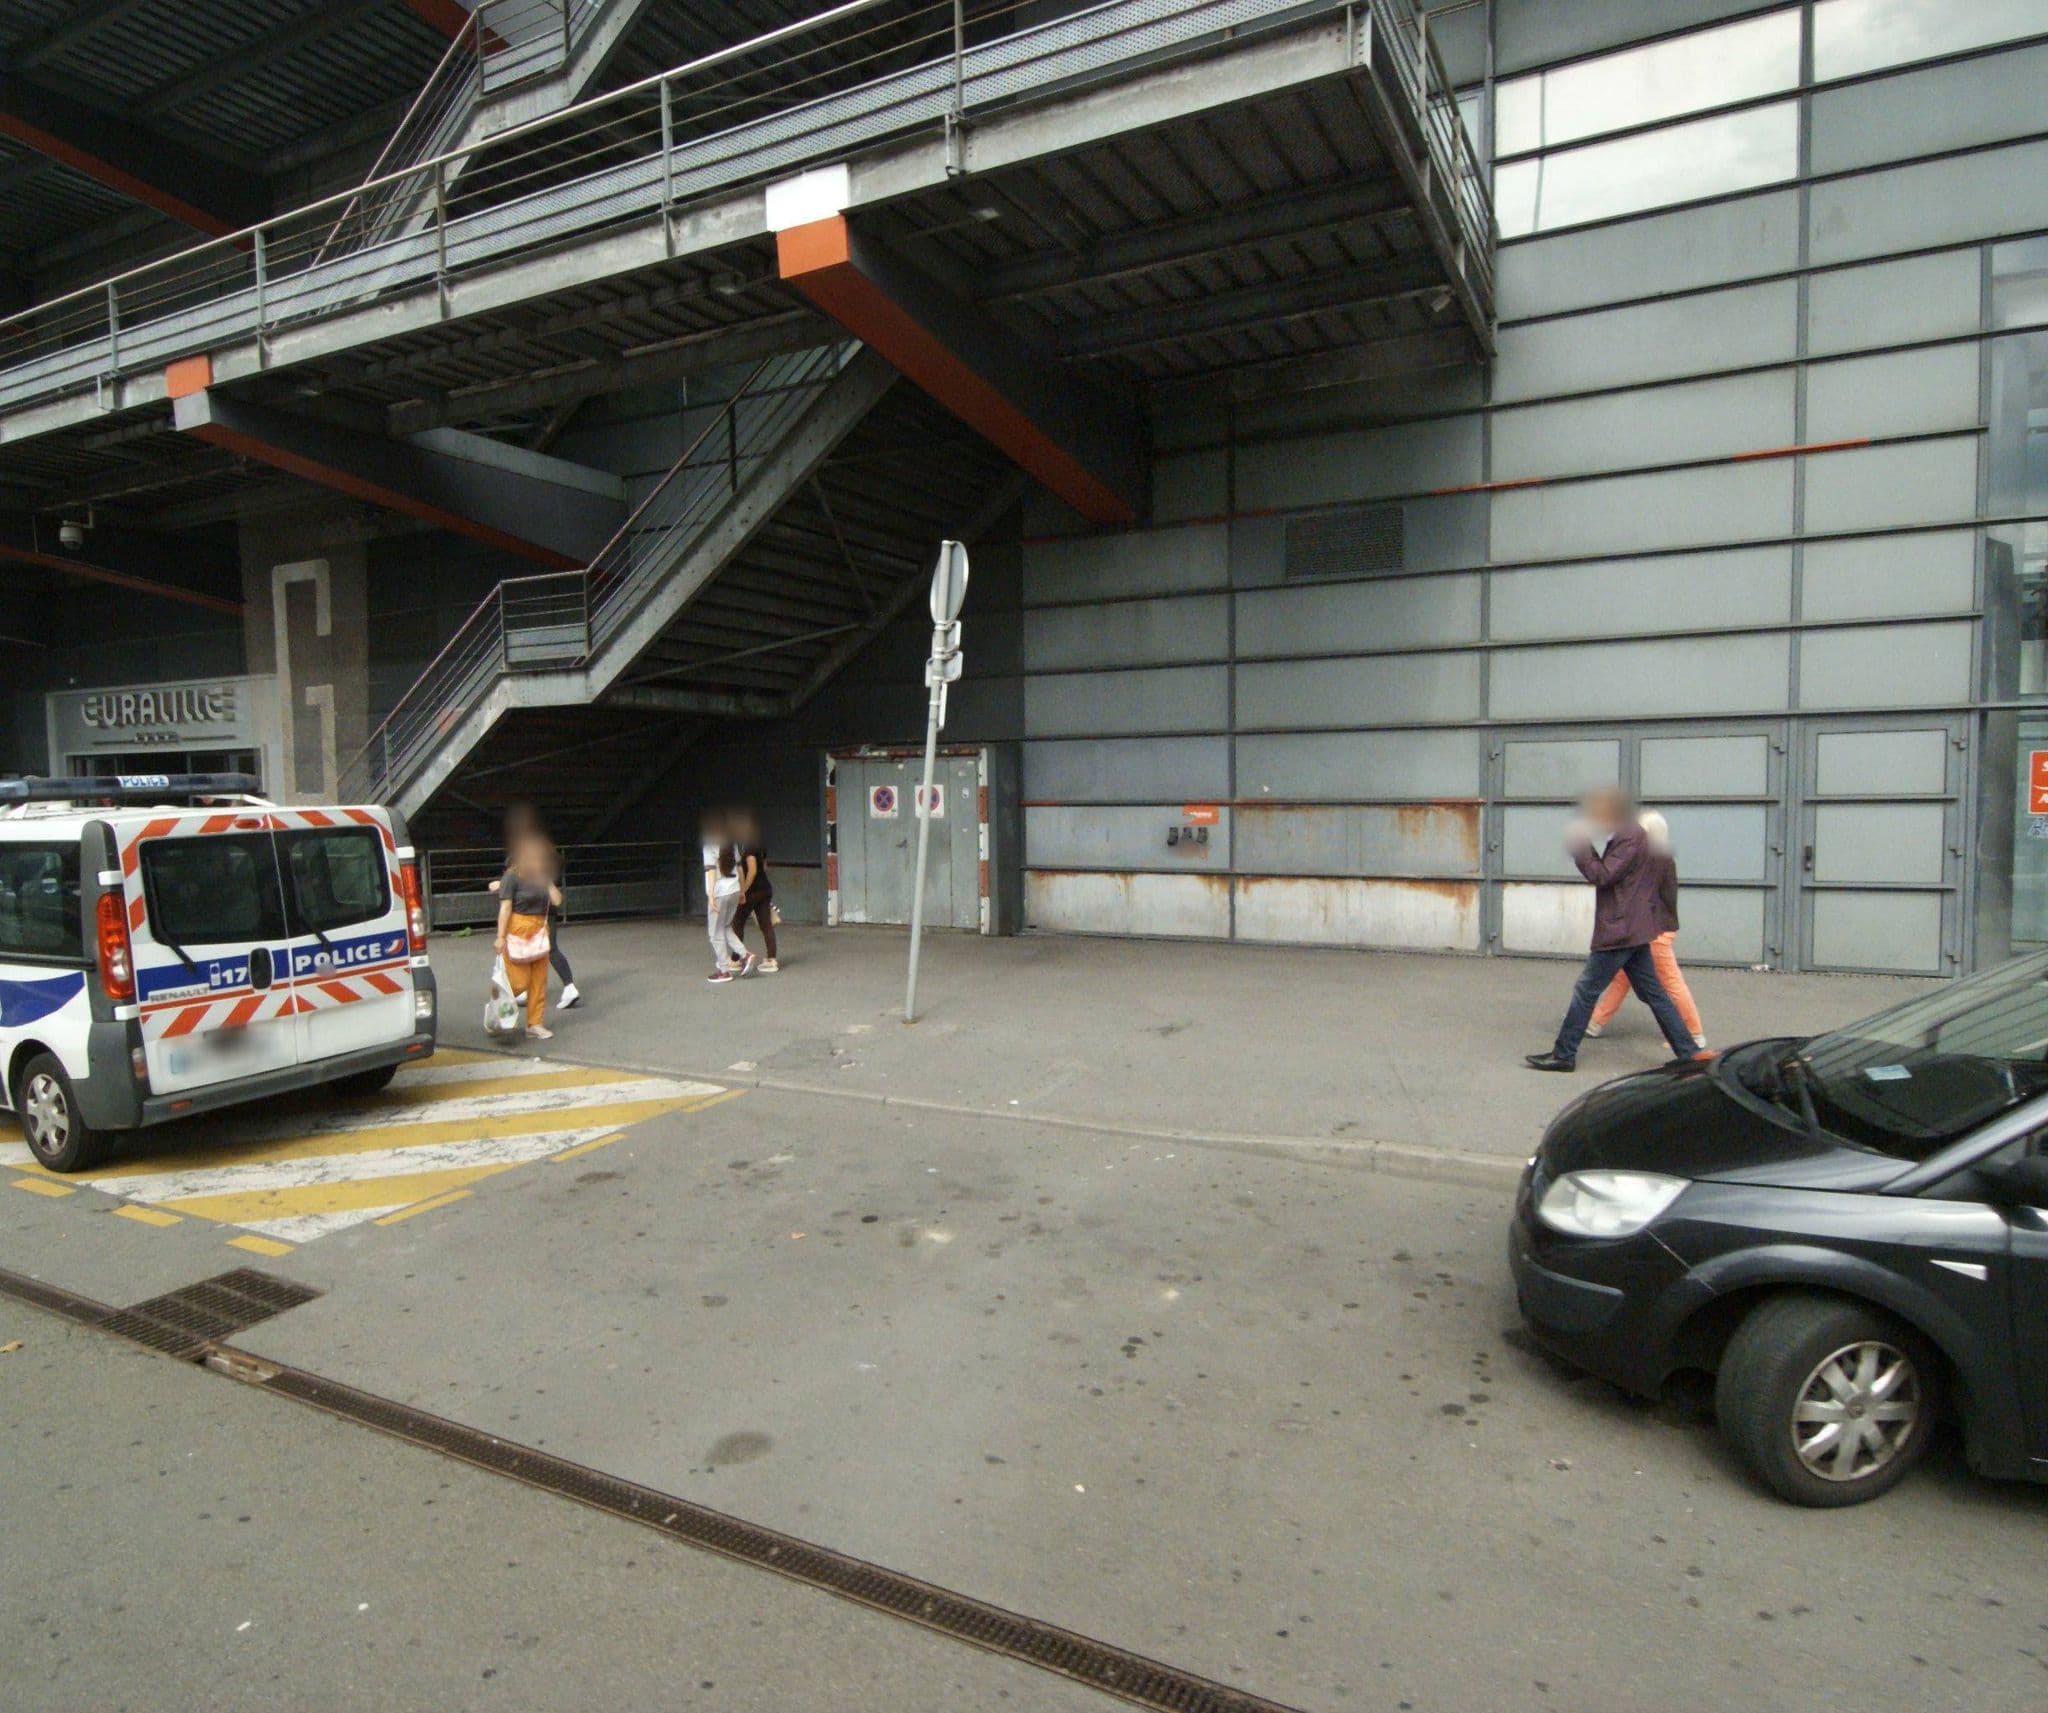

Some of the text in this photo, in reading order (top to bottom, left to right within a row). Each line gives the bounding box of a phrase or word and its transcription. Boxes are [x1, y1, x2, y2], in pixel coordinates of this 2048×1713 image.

[81, 688, 233, 727] EURALILLE
[122, 777, 166, 786] POLICE
[295, 942, 382, 972] POLICE
[221, 966, 248, 984] 17
[149, 986, 209, 1001] RENAULT
